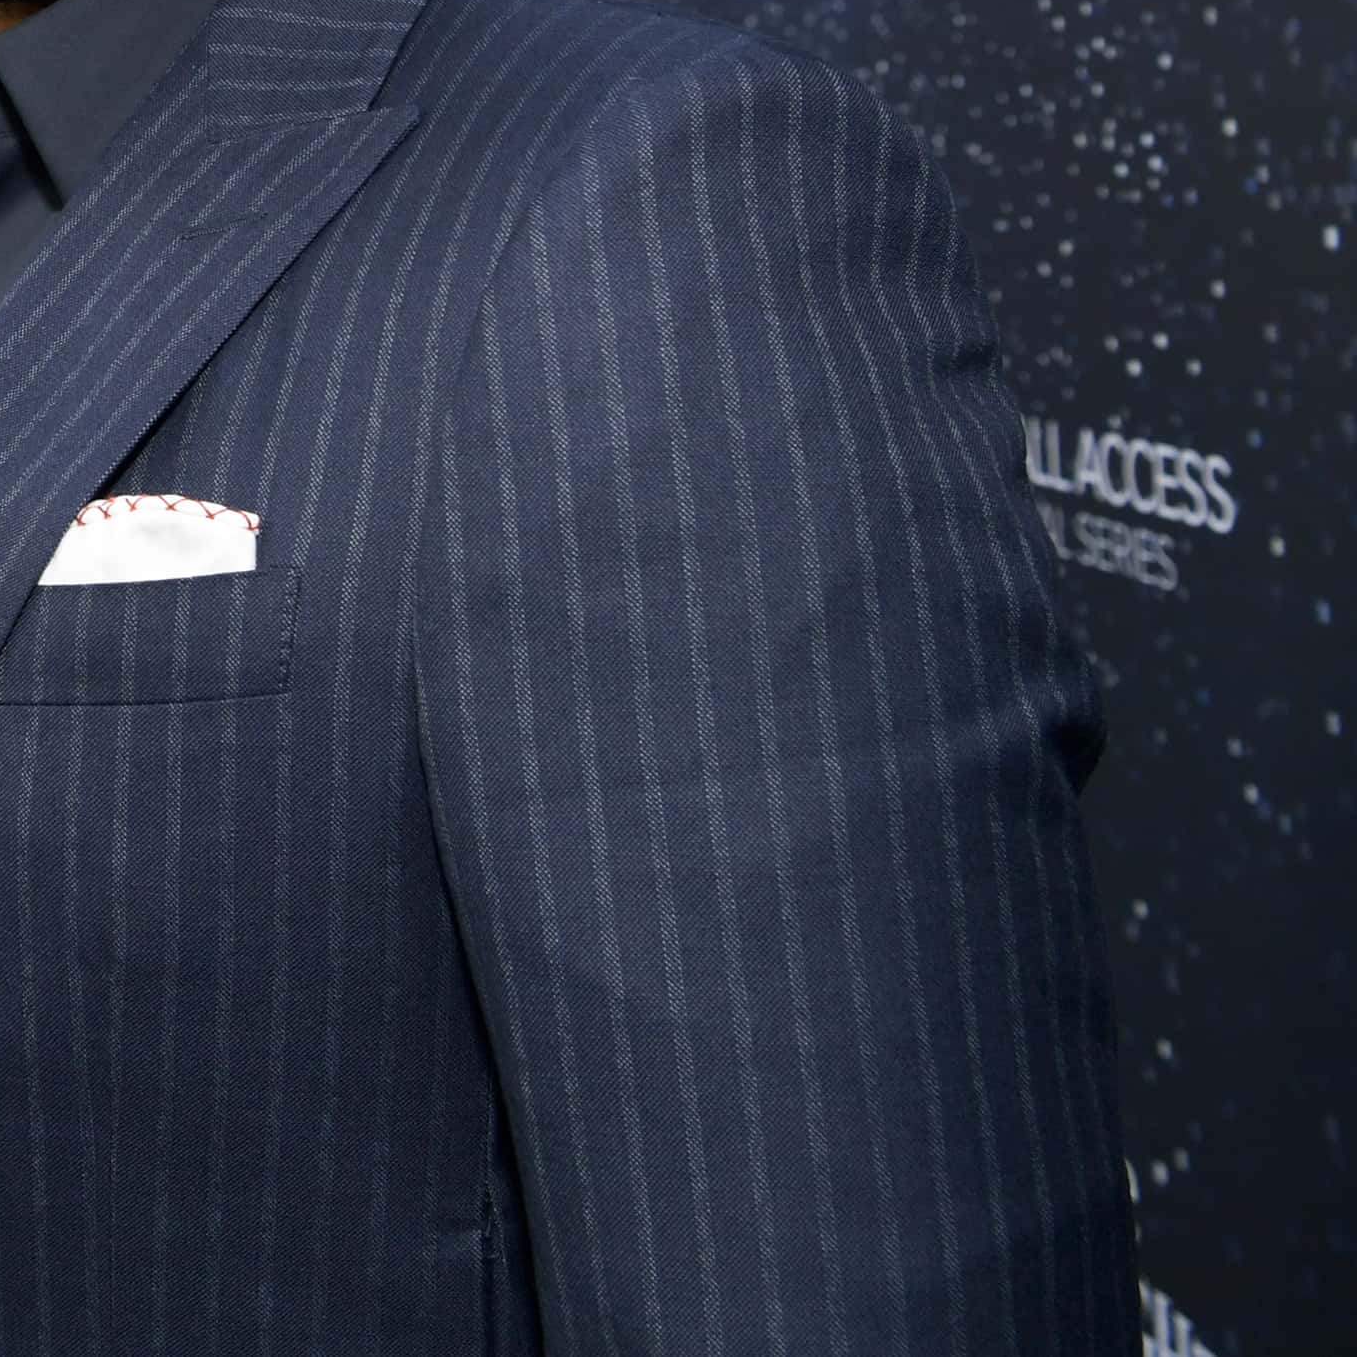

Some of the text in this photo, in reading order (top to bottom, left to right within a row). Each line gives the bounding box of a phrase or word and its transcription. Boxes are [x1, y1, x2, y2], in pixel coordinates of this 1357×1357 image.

[1024, 415, 1074, 492] LL
[1074, 427, 1236, 534] ACCESS
[1074, 511, 1180, 591] SERIES
